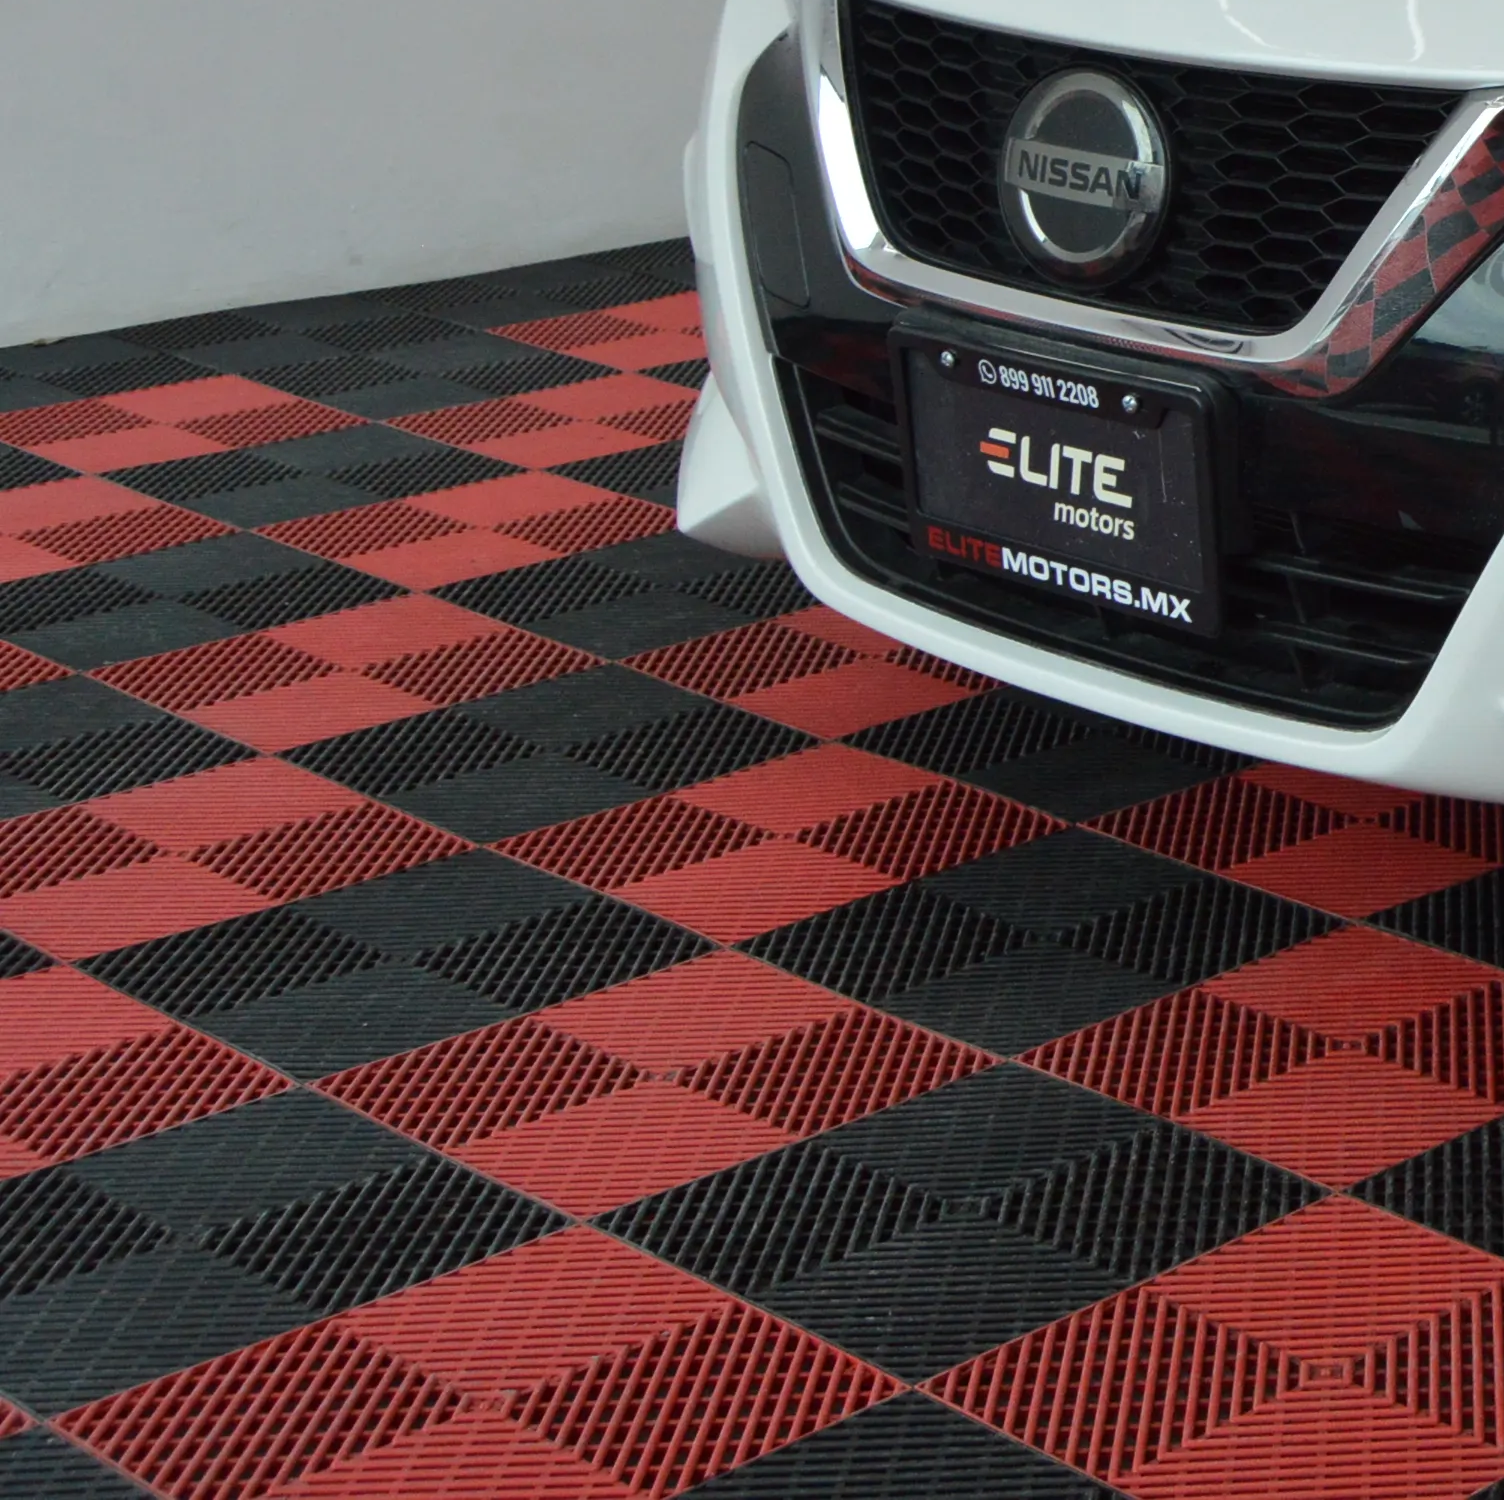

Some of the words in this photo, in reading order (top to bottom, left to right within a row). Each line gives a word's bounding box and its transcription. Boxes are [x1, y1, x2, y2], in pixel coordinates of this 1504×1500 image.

[1018, 151, 1142, 199] NISSAN
[999, 366, 1028, 392] 899
[1032, 373, 1055, 399] 911
[1057, 379, 1100, 408] 2208
[980, 427, 1133, 509] ELITE
[1053, 502, 1135, 540] motors
[927, 525, 1193, 623] ELITEMOTORS.MX
